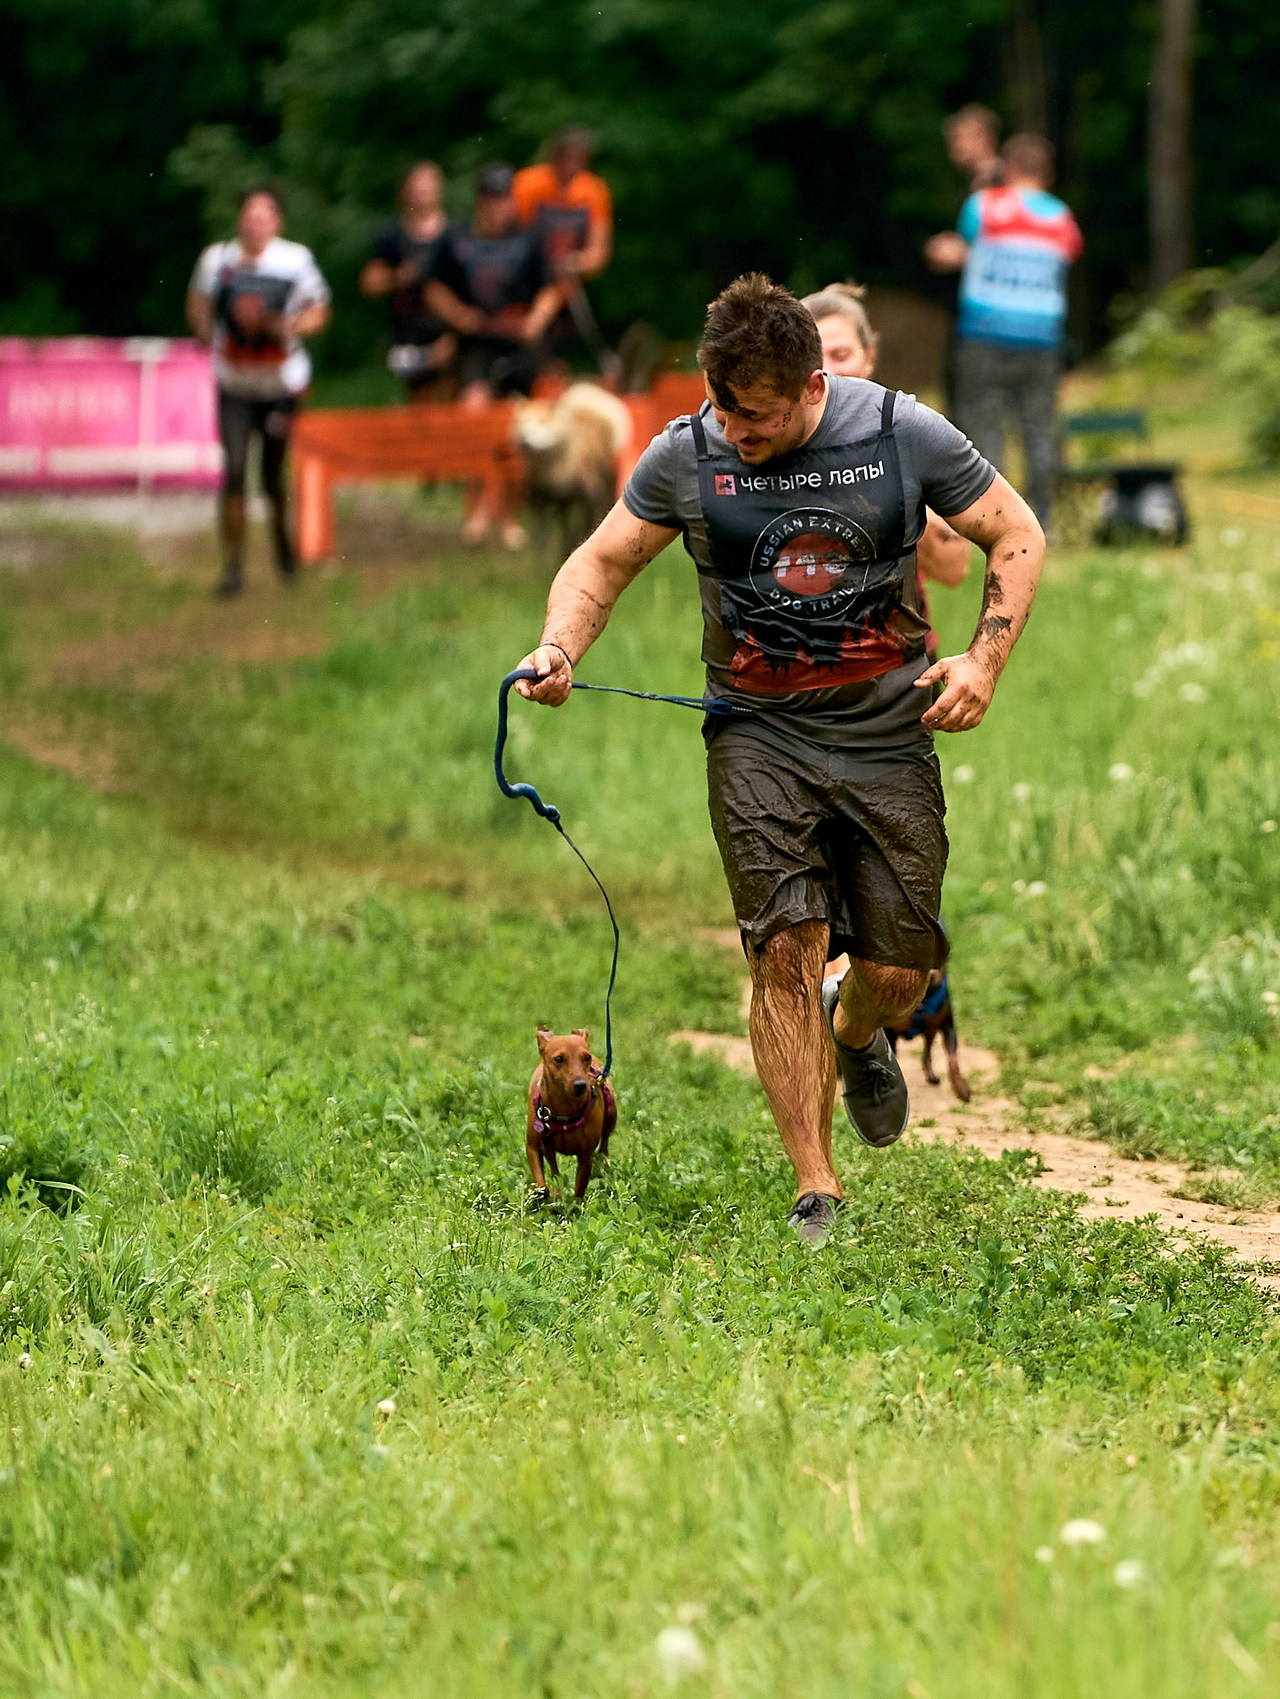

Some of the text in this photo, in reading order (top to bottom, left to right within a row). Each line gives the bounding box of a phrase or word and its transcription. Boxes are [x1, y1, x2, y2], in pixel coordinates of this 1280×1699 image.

[829, 460, 885, 486] лапы
[759, 516, 865, 568] USSIAN EXTRE
[769, 587, 854, 611] DOG TRAIL
